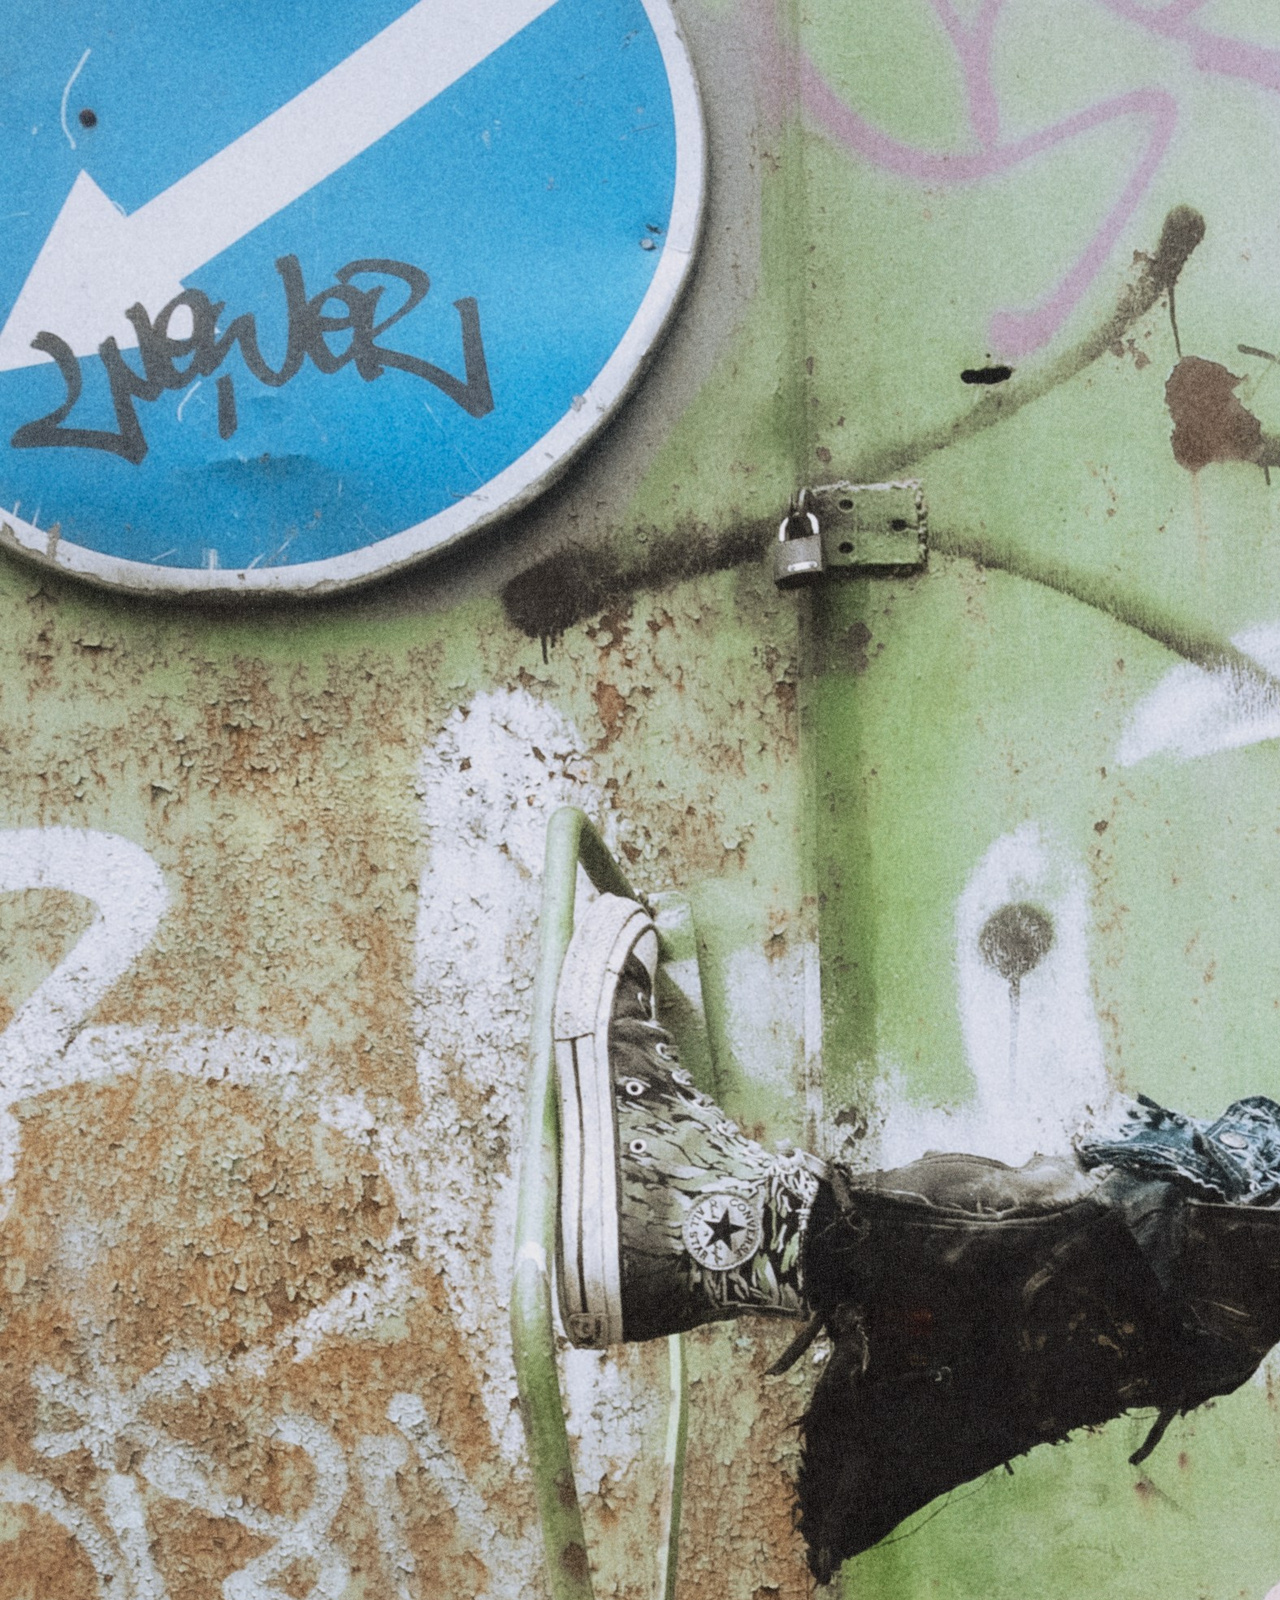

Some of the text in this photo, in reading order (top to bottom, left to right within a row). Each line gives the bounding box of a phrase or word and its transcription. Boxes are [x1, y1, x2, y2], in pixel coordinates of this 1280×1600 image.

[689, 1206, 709, 1261] ALL STAR
[729, 1198, 757, 1257] CONVERSE
